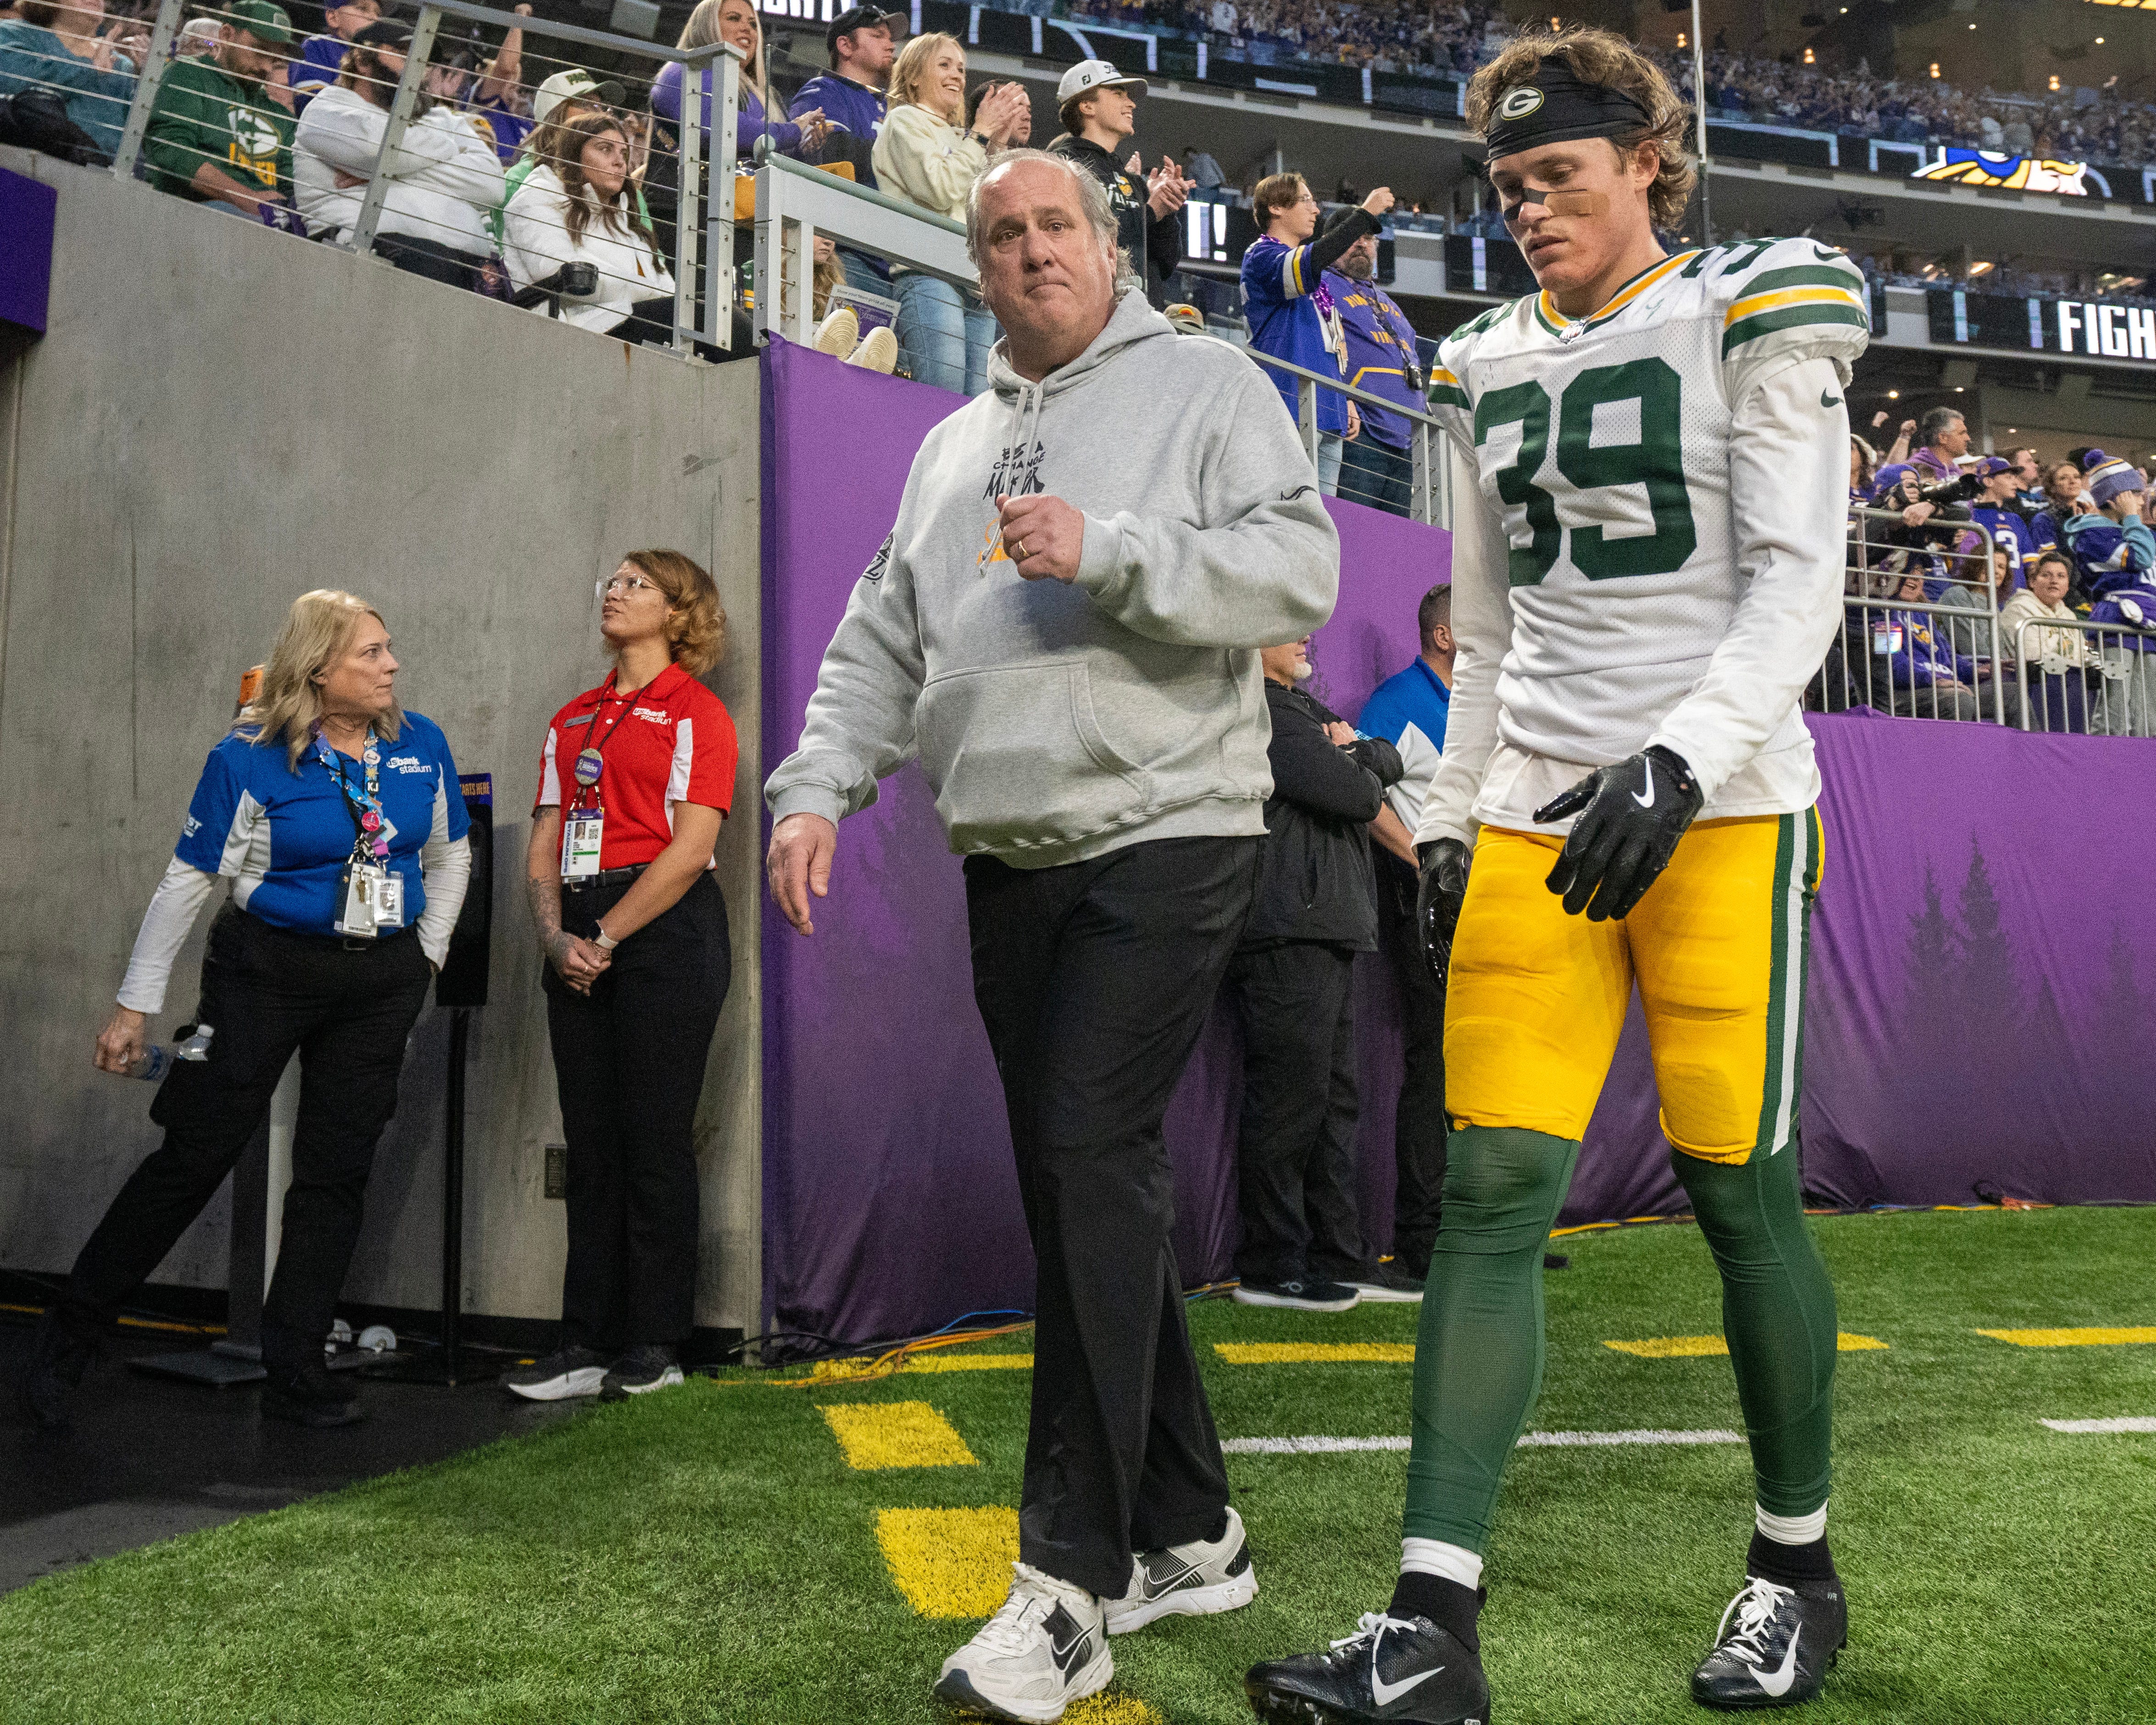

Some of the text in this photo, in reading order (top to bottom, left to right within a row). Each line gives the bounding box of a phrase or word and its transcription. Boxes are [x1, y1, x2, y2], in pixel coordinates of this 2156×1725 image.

[1082, 74, 1091, 85] FJ
[1501, 88, 1542, 118] G
[993, 451, 1046, 470] CHANGE
[1475, 356, 1697, 586] 39
[399, 764, 432, 774] stadium
[368, 782, 379, 792] KJ
[459, 783, 475, 796] ARTS
